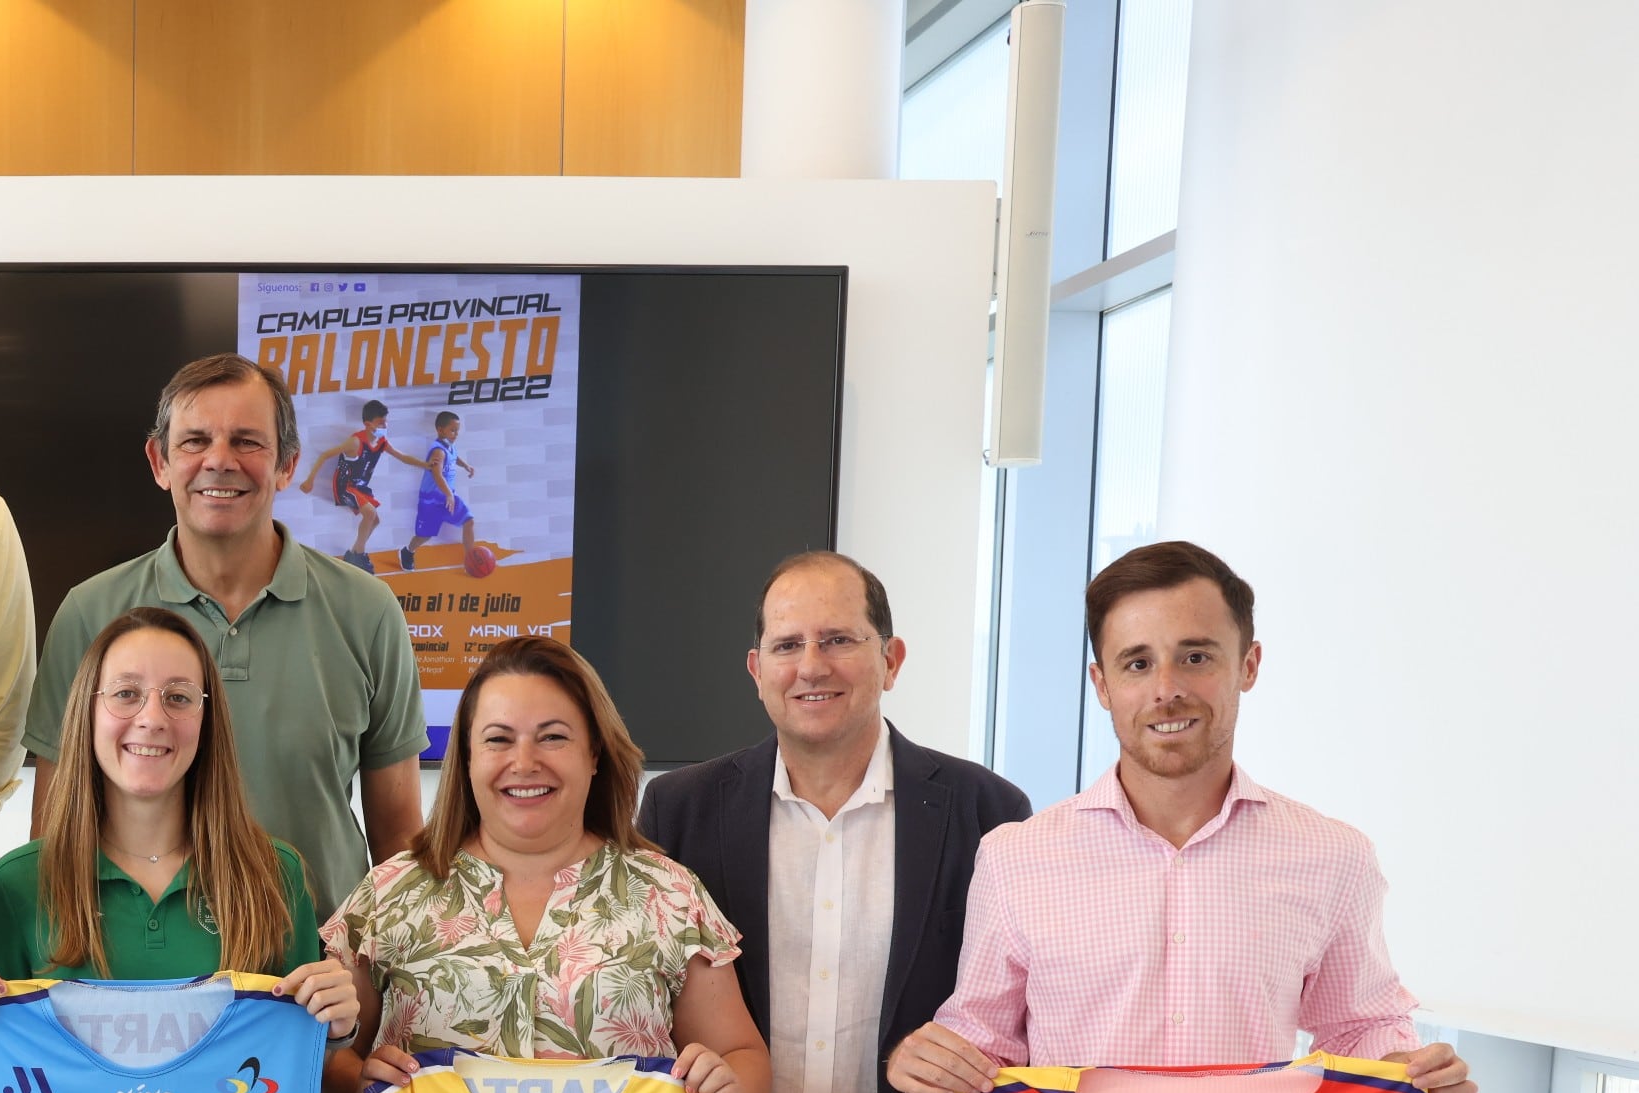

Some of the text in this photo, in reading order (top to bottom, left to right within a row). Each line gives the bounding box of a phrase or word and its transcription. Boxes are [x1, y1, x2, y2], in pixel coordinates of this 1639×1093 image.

[257, 282, 302, 295] Síguenos:
[256, 293, 562, 334] CAMPUS PROVINCIAL
[256, 315, 561, 396] BALONCESTO
[447, 374, 553, 406] 2022
[397, 593, 522, 618] nio al 1 de julio
[407, 624, 444, 638] ROX
[469, 624, 553, 638] MANILVA
